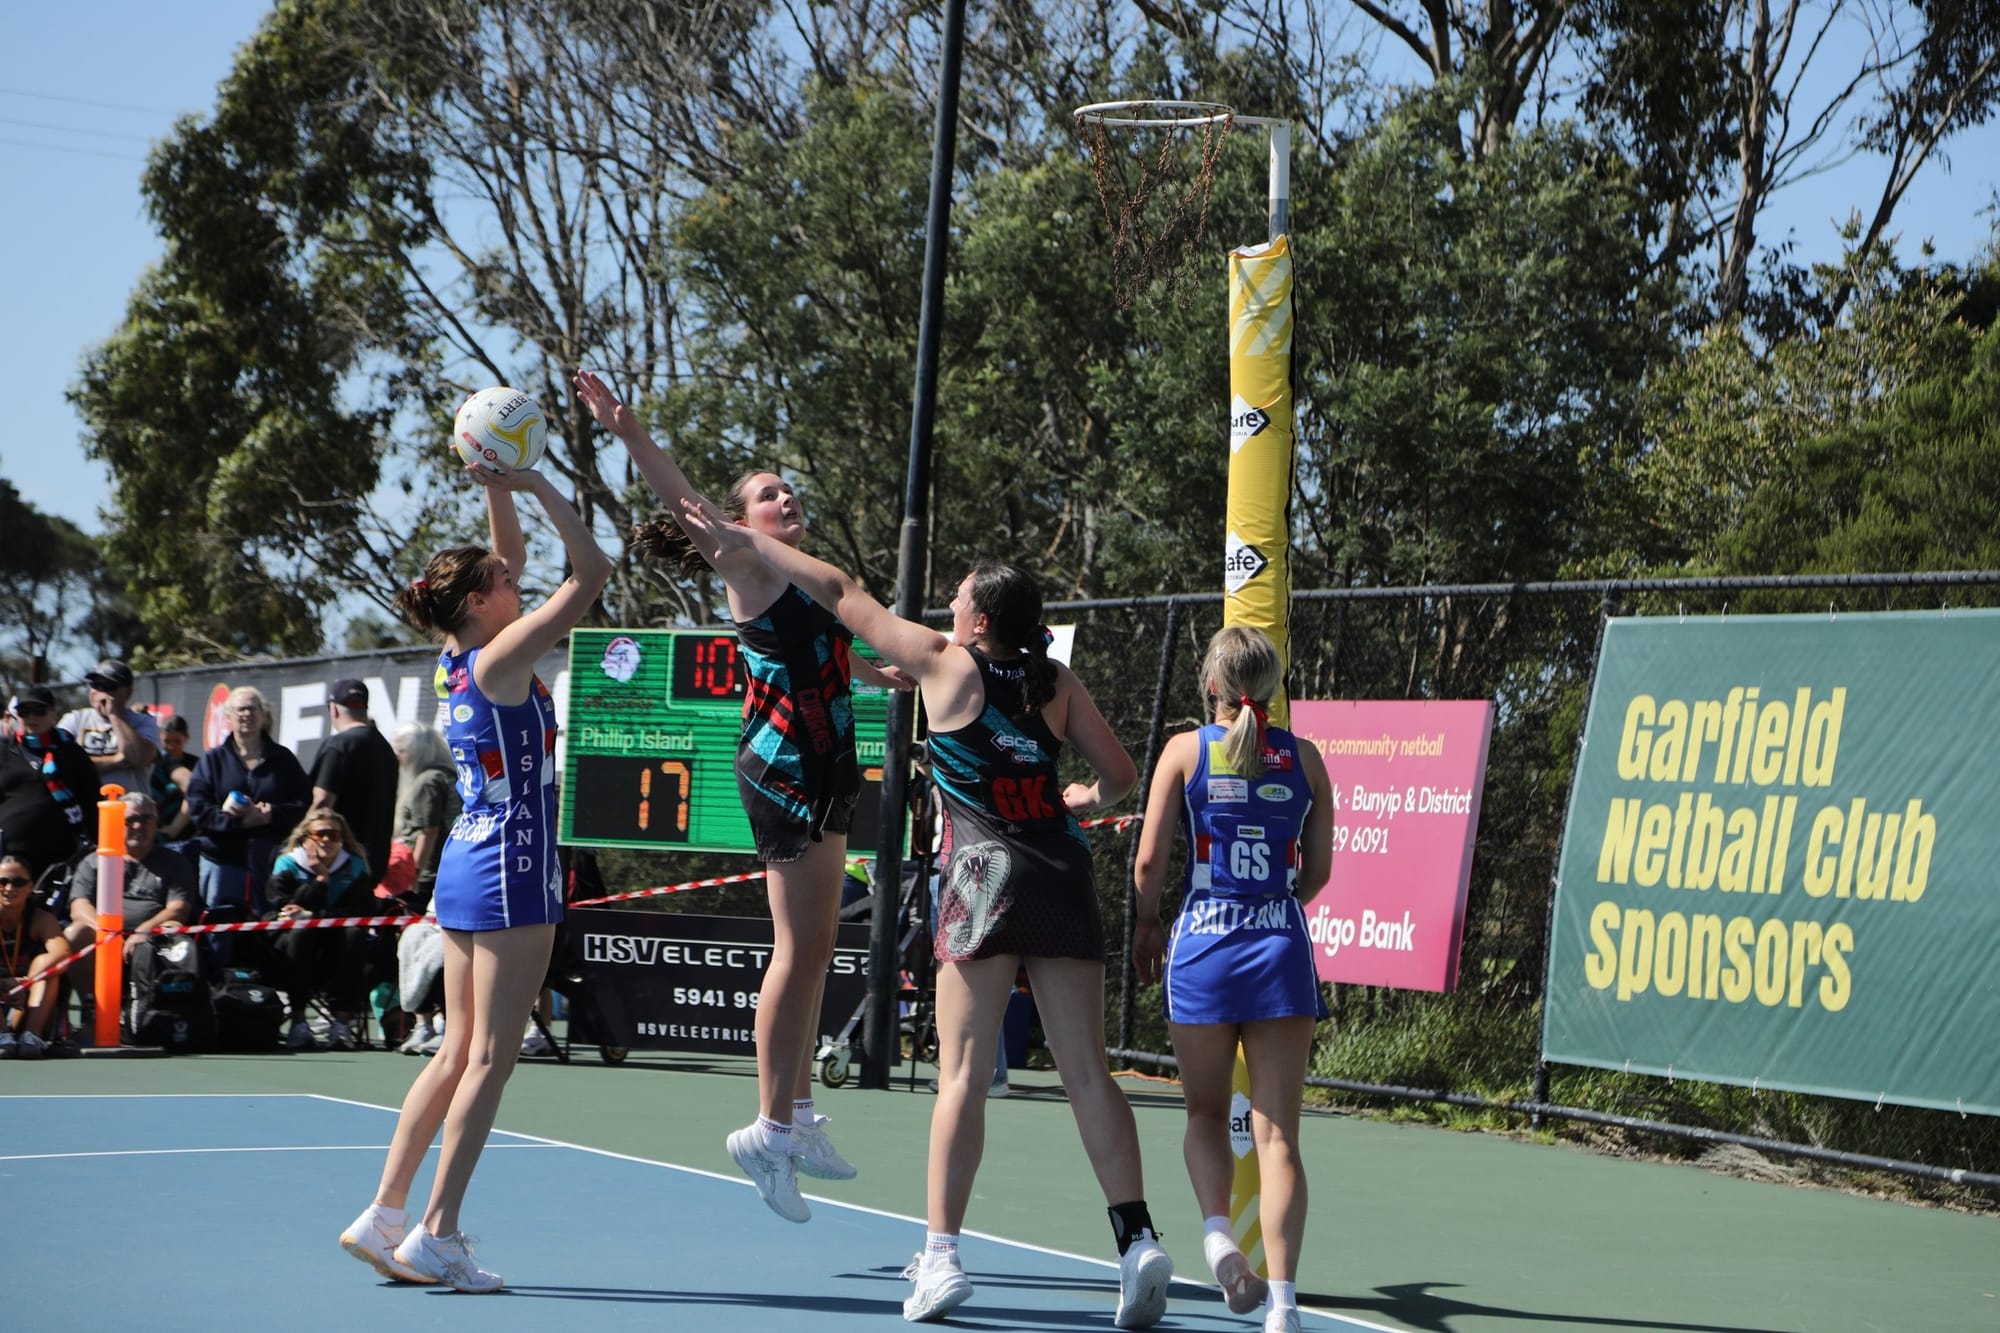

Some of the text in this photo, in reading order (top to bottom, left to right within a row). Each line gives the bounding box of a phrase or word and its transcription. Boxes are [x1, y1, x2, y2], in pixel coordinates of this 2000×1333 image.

[497, 395, 529, 421] BERT
[1231, 412, 1259, 428] afe
[1226, 549, 1256, 571] afe
[581, 727, 693, 754] Phillip Island
[1329, 734, 1398, 763] community
[1400, 733, 1445, 757] netball
[1617, 686, 1847, 787] Garfield
[638, 761, 689, 832] 17
[992, 775, 1057, 821] GK
[1352, 784, 1401, 820] Bunyip
[1404, 789, 1416, 812] &
[1418, 787, 1473, 814] District
[1351, 827, 1389, 854] 6091
[1596, 792, 1936, 903] Netball Club
[1230, 841, 1271, 881] GS
[1307, 905, 1416, 957] digo Bank
[1585, 901, 1854, 1012] Sponsors
[673, 987, 760, 1009] 5941 99
[637, 1022, 757, 1042] HSVELECTRICS
[1229, 1110, 1251, 1132] af
